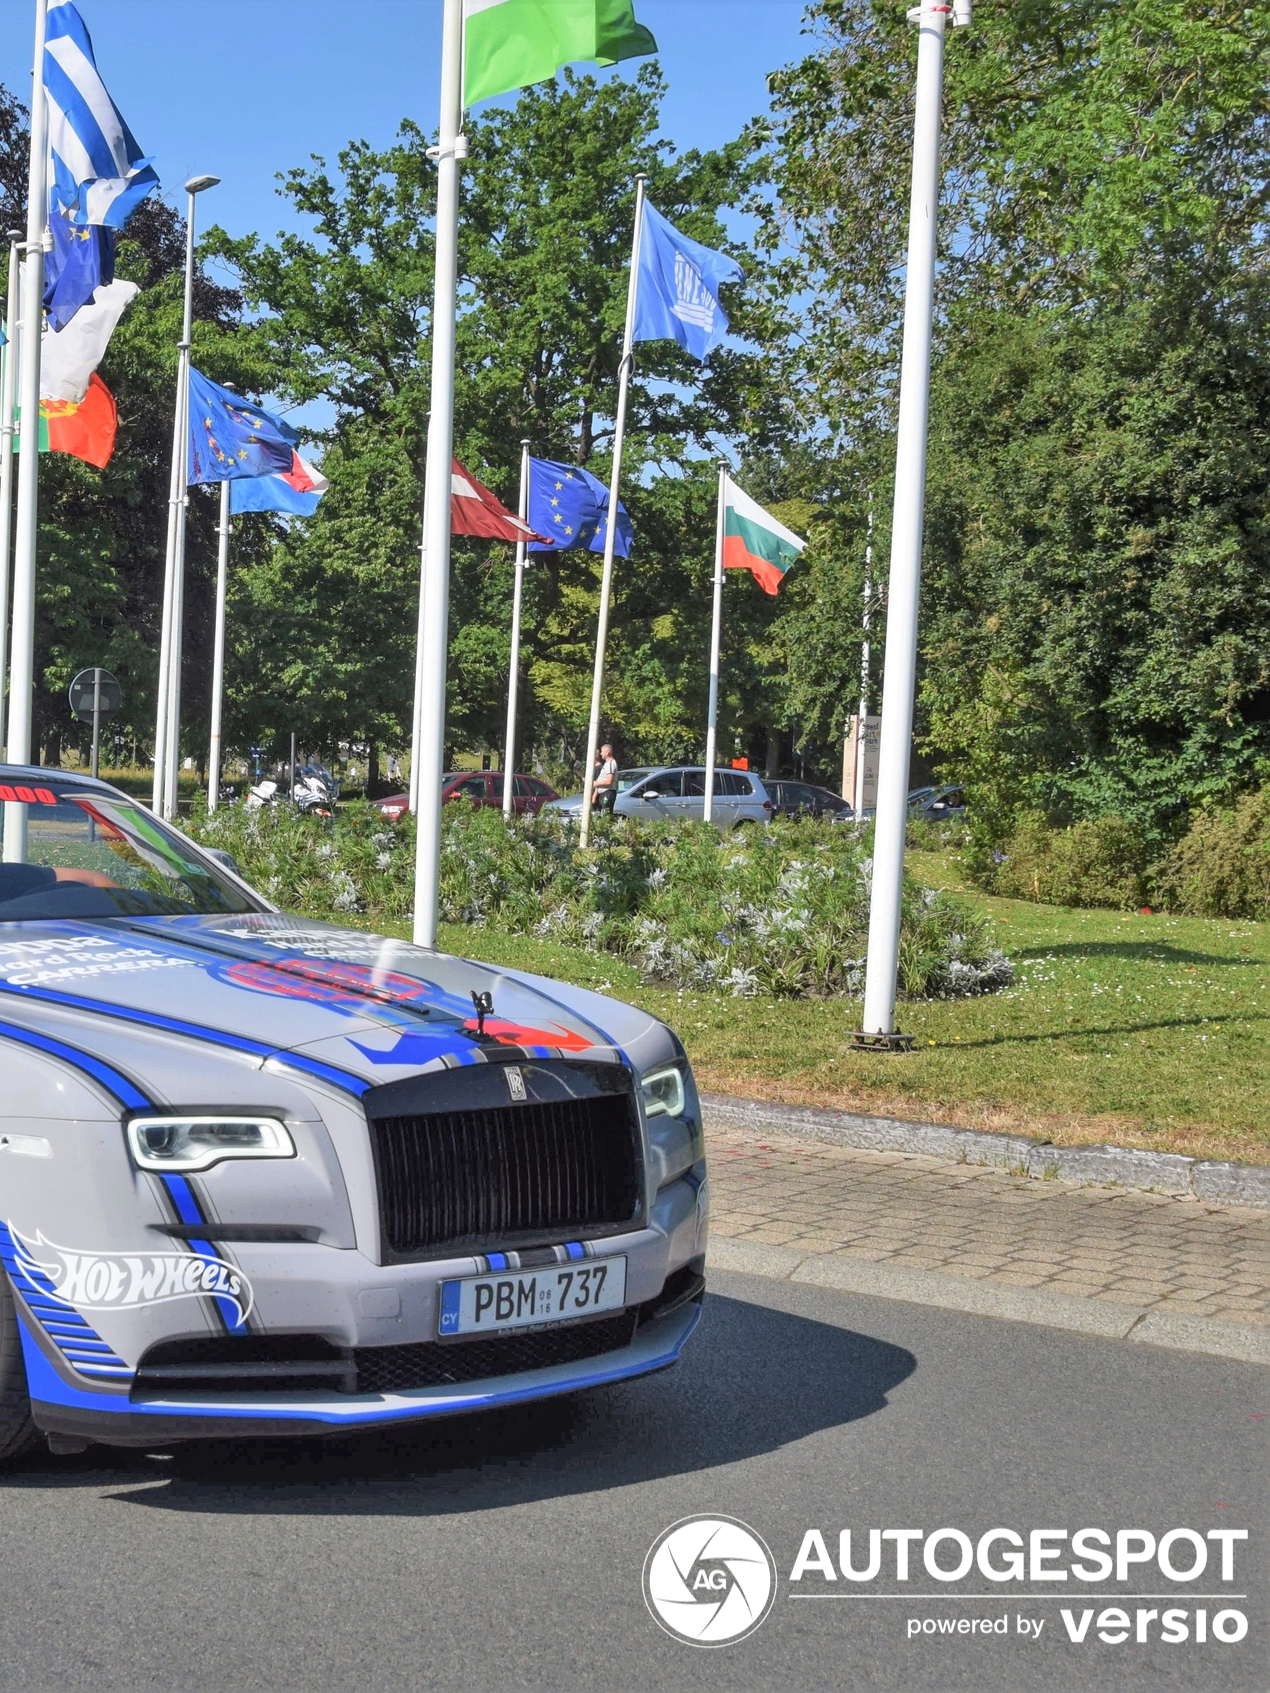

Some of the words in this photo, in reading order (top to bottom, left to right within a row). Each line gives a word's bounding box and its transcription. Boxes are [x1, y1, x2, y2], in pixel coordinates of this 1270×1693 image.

[67, 948, 170, 963] Rock
[6, 957, 198, 985] CARRERA
[474, 1277, 537, 1323] PBM
[557, 1265, 608, 1311] 737
[539, 1289, 552, 1300] 08
[539, 1303, 551, 1315] 16
[441, 1312, 458, 1326] CY
